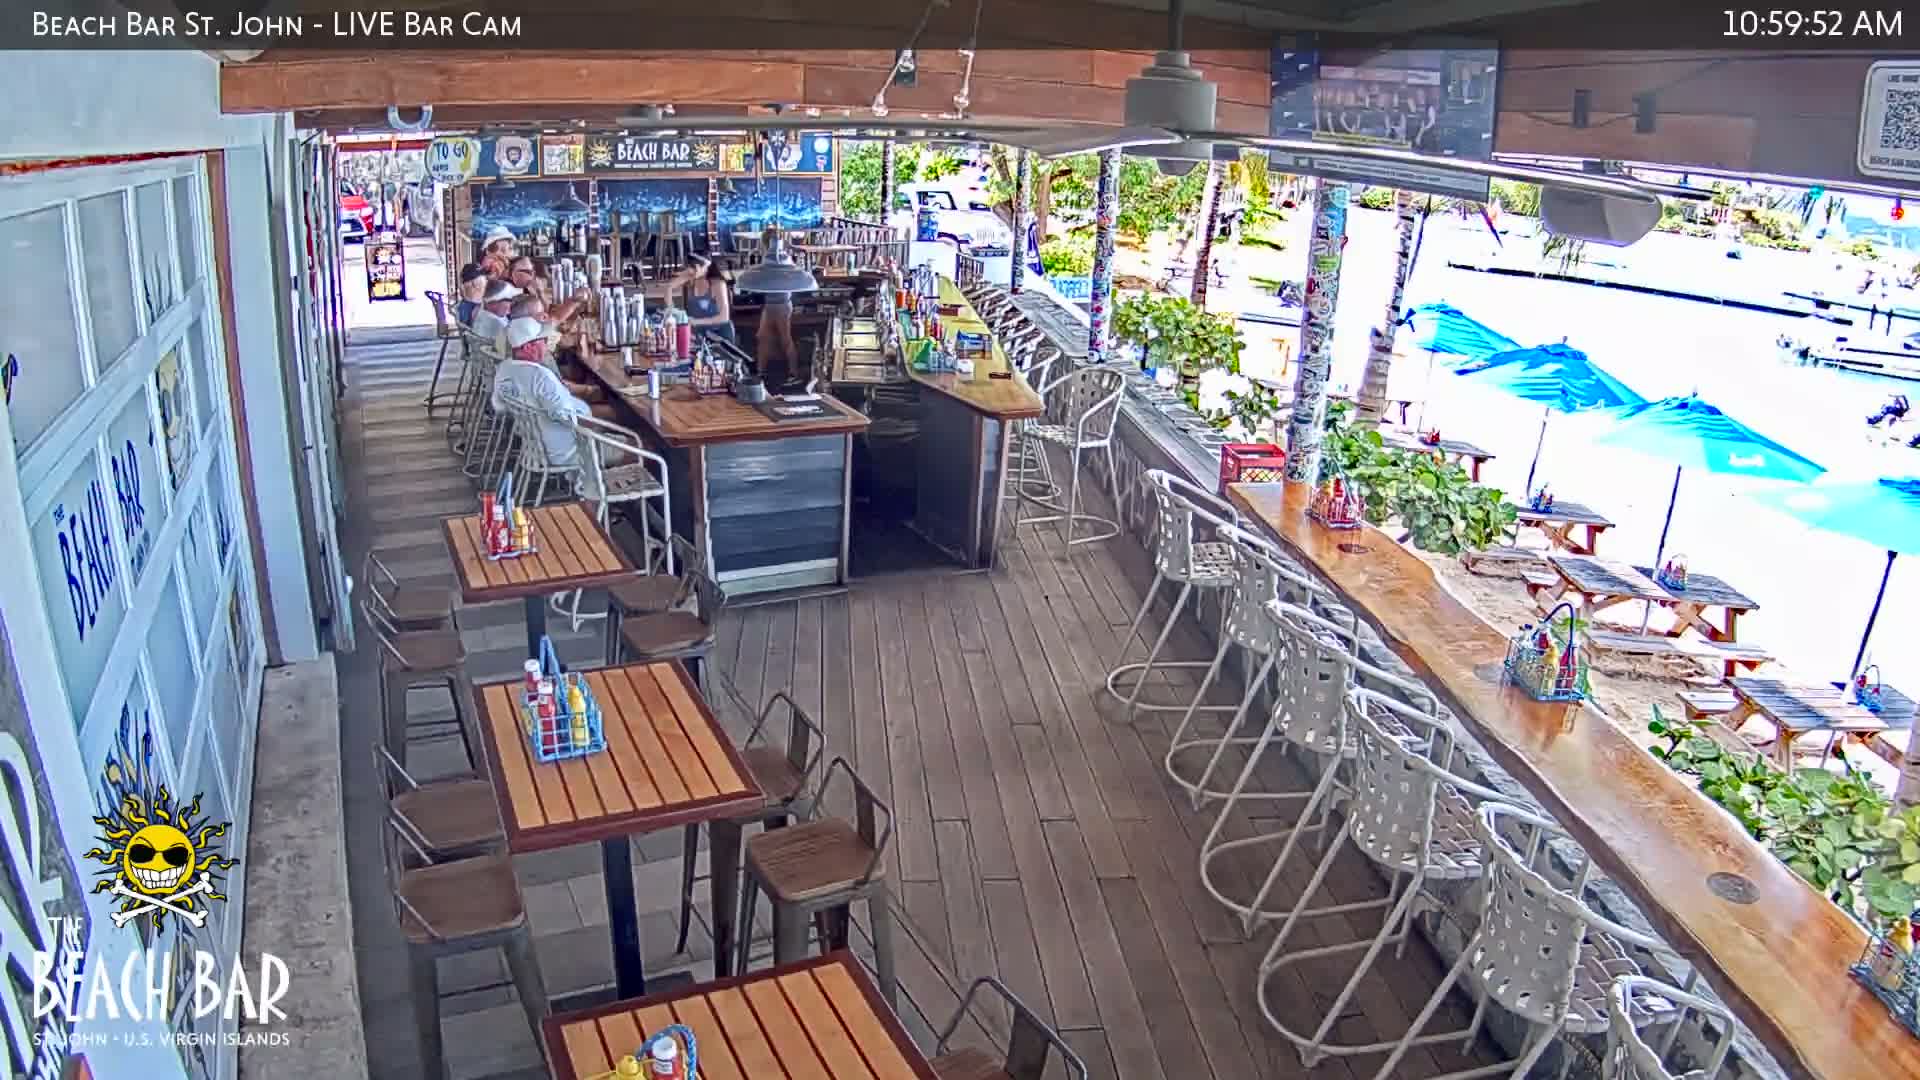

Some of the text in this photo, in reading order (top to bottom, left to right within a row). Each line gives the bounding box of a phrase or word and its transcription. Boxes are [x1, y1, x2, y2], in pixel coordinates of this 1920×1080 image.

[617, 141, 691, 161] BEACH BAR
[111, 438, 146, 546] BAR
